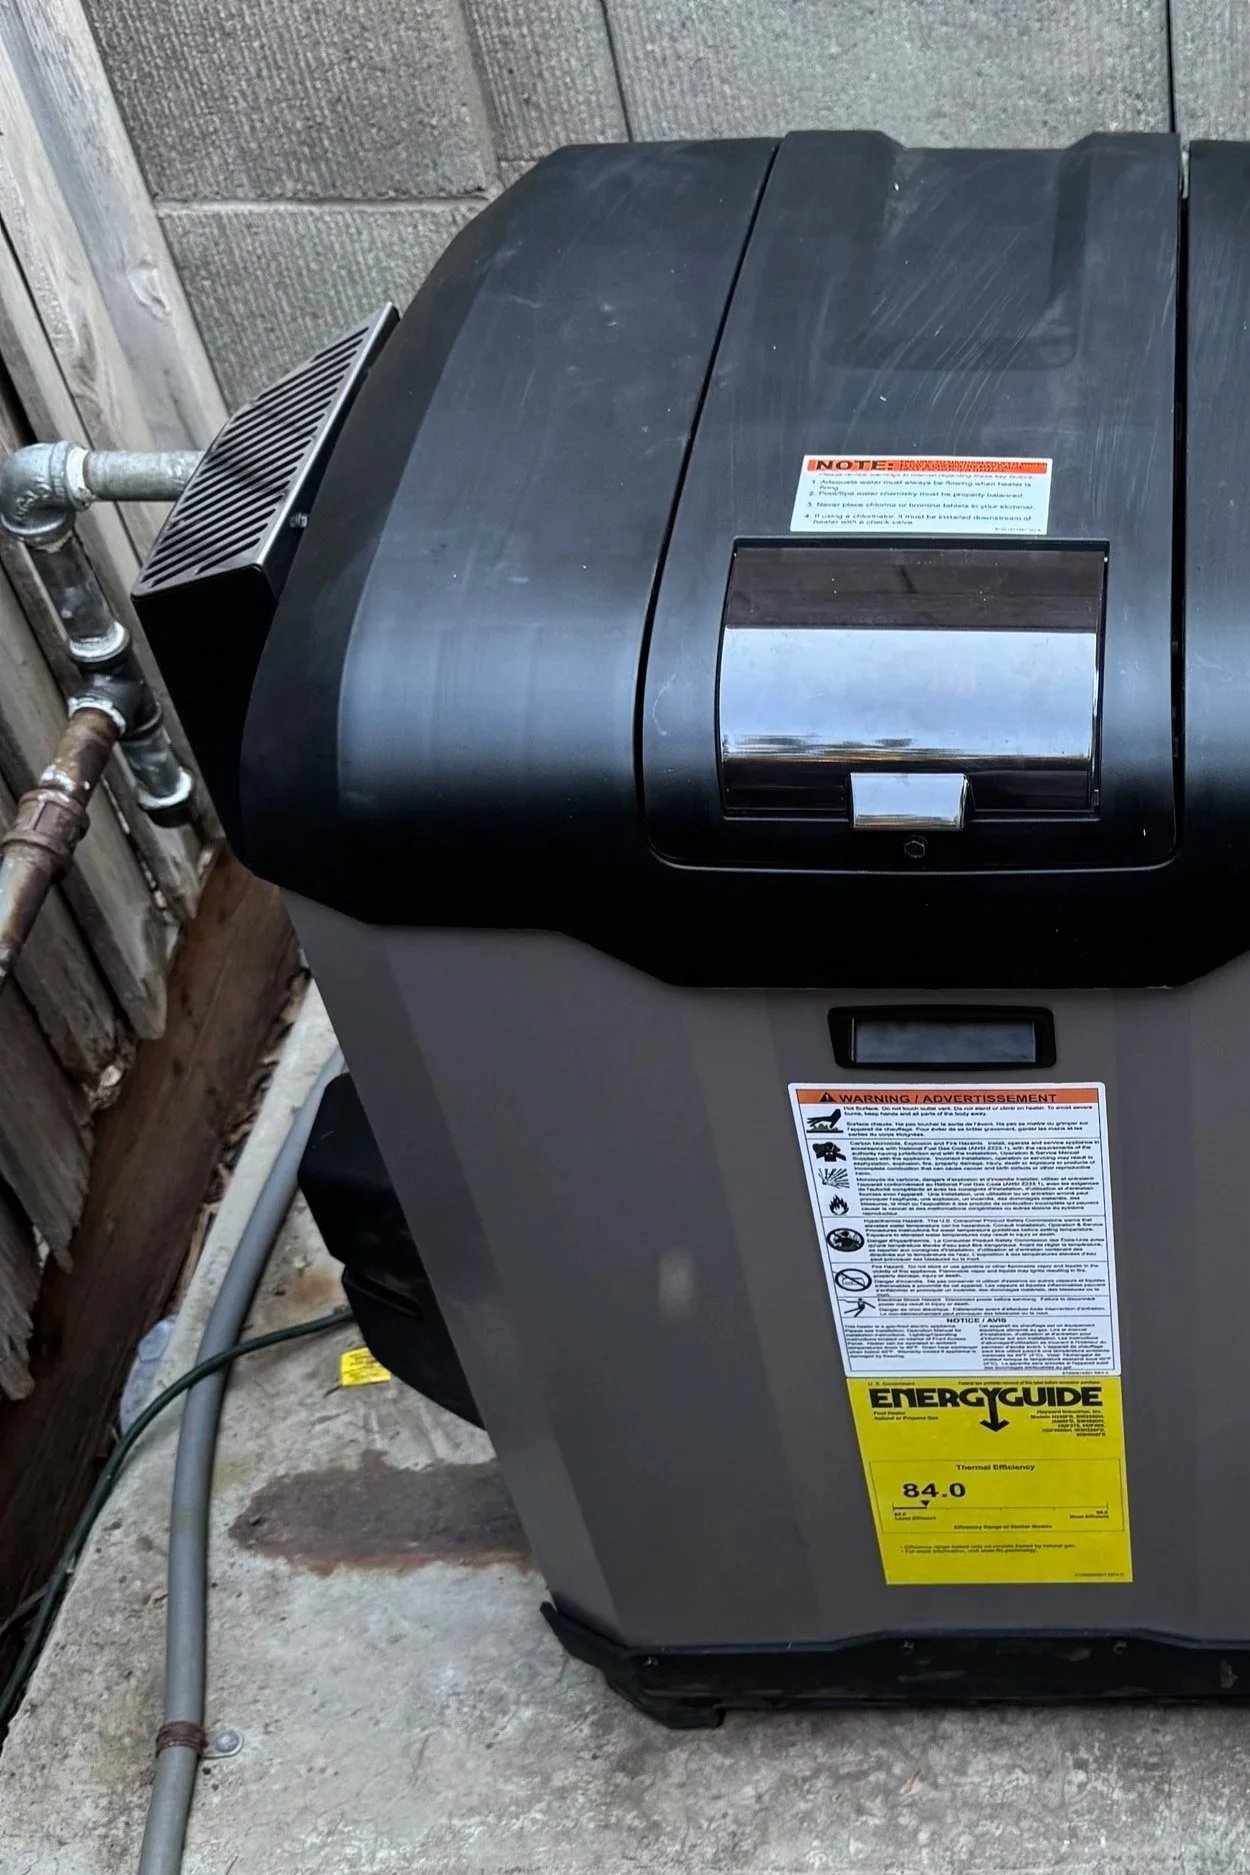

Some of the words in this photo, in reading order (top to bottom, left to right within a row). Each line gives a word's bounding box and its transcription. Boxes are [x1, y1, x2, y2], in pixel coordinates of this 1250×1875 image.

[816, 460, 894, 470] NOTE:
[839, 1094, 910, 1103] WARNING
[914, 1094, 918, 1103] /
[924, 1094, 1057, 1103] ADVERTISSEMENT
[868, 1387, 1103, 1408] ENERGYGUIDE
[903, 1483, 966, 1498] 84.0
